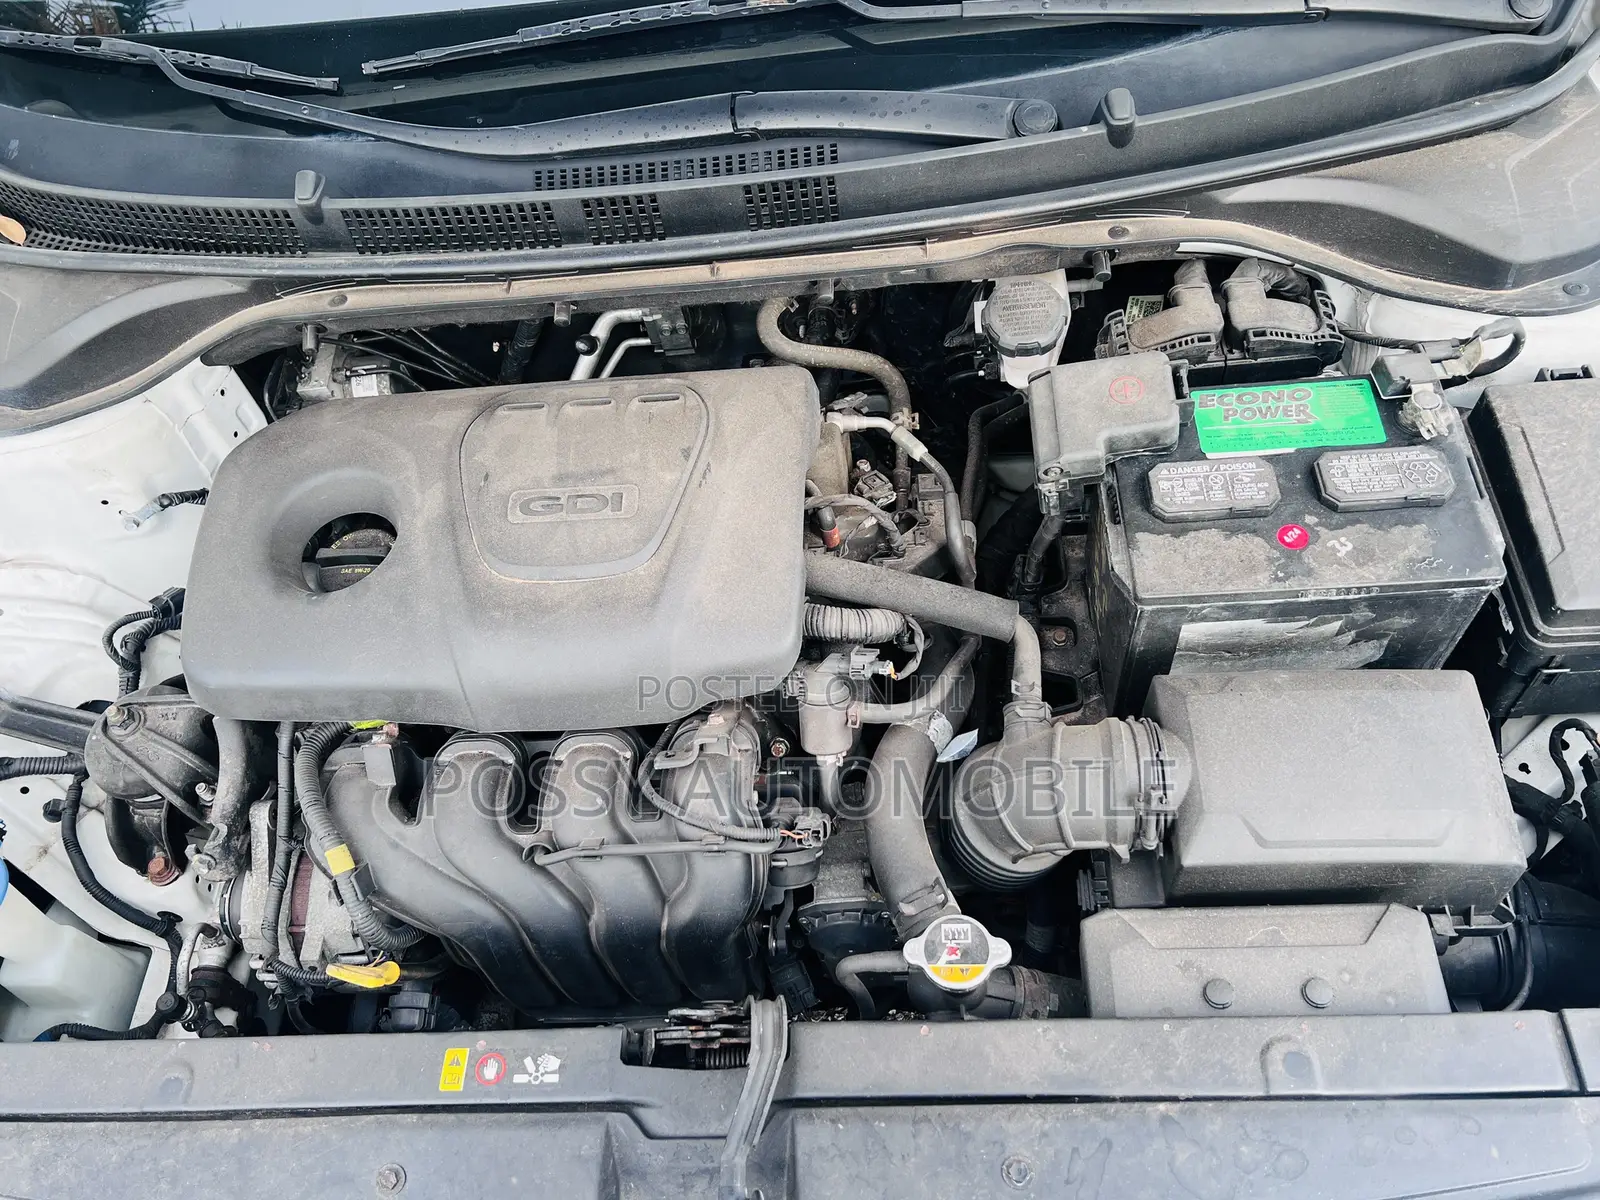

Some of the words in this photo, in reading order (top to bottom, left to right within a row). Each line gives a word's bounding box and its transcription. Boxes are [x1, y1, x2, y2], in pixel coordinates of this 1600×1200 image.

[1198, 387, 1312, 408] ECONO
[1223, 403, 1319, 424] POWER
[1170, 465, 1210, 474] DANGER
[1220, 461, 1256, 471] POISON
[519, 492, 623, 516] GDI
